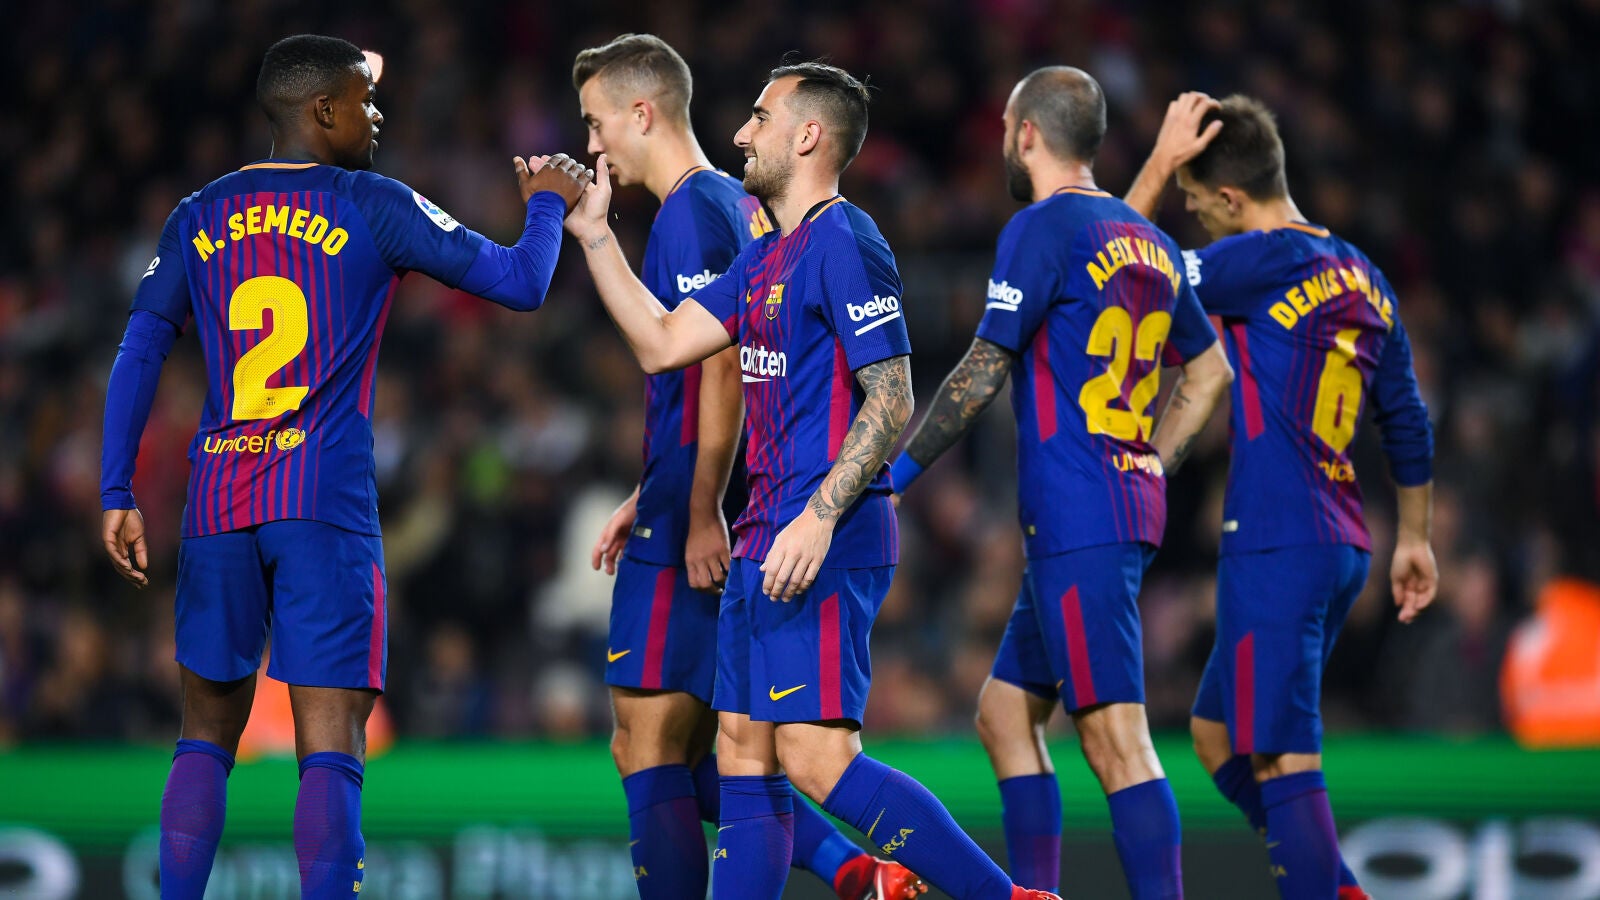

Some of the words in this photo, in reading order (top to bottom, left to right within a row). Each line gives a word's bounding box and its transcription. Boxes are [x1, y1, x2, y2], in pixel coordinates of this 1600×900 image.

[192, 229, 225, 262] N.
[228, 204, 349, 256] SEMEDO
[677, 269, 727, 293] bek
[1086, 236, 1139, 291] ALEIX
[846, 294, 899, 322] beko
[1268, 267, 1343, 330] DENIS
[229, 275, 309, 420] 2
[1078, 305, 1172, 443] 22
[1312, 328, 1361, 454] 6
[203, 430, 276, 454] unicef
[881, 828, 914, 854] RÇA
